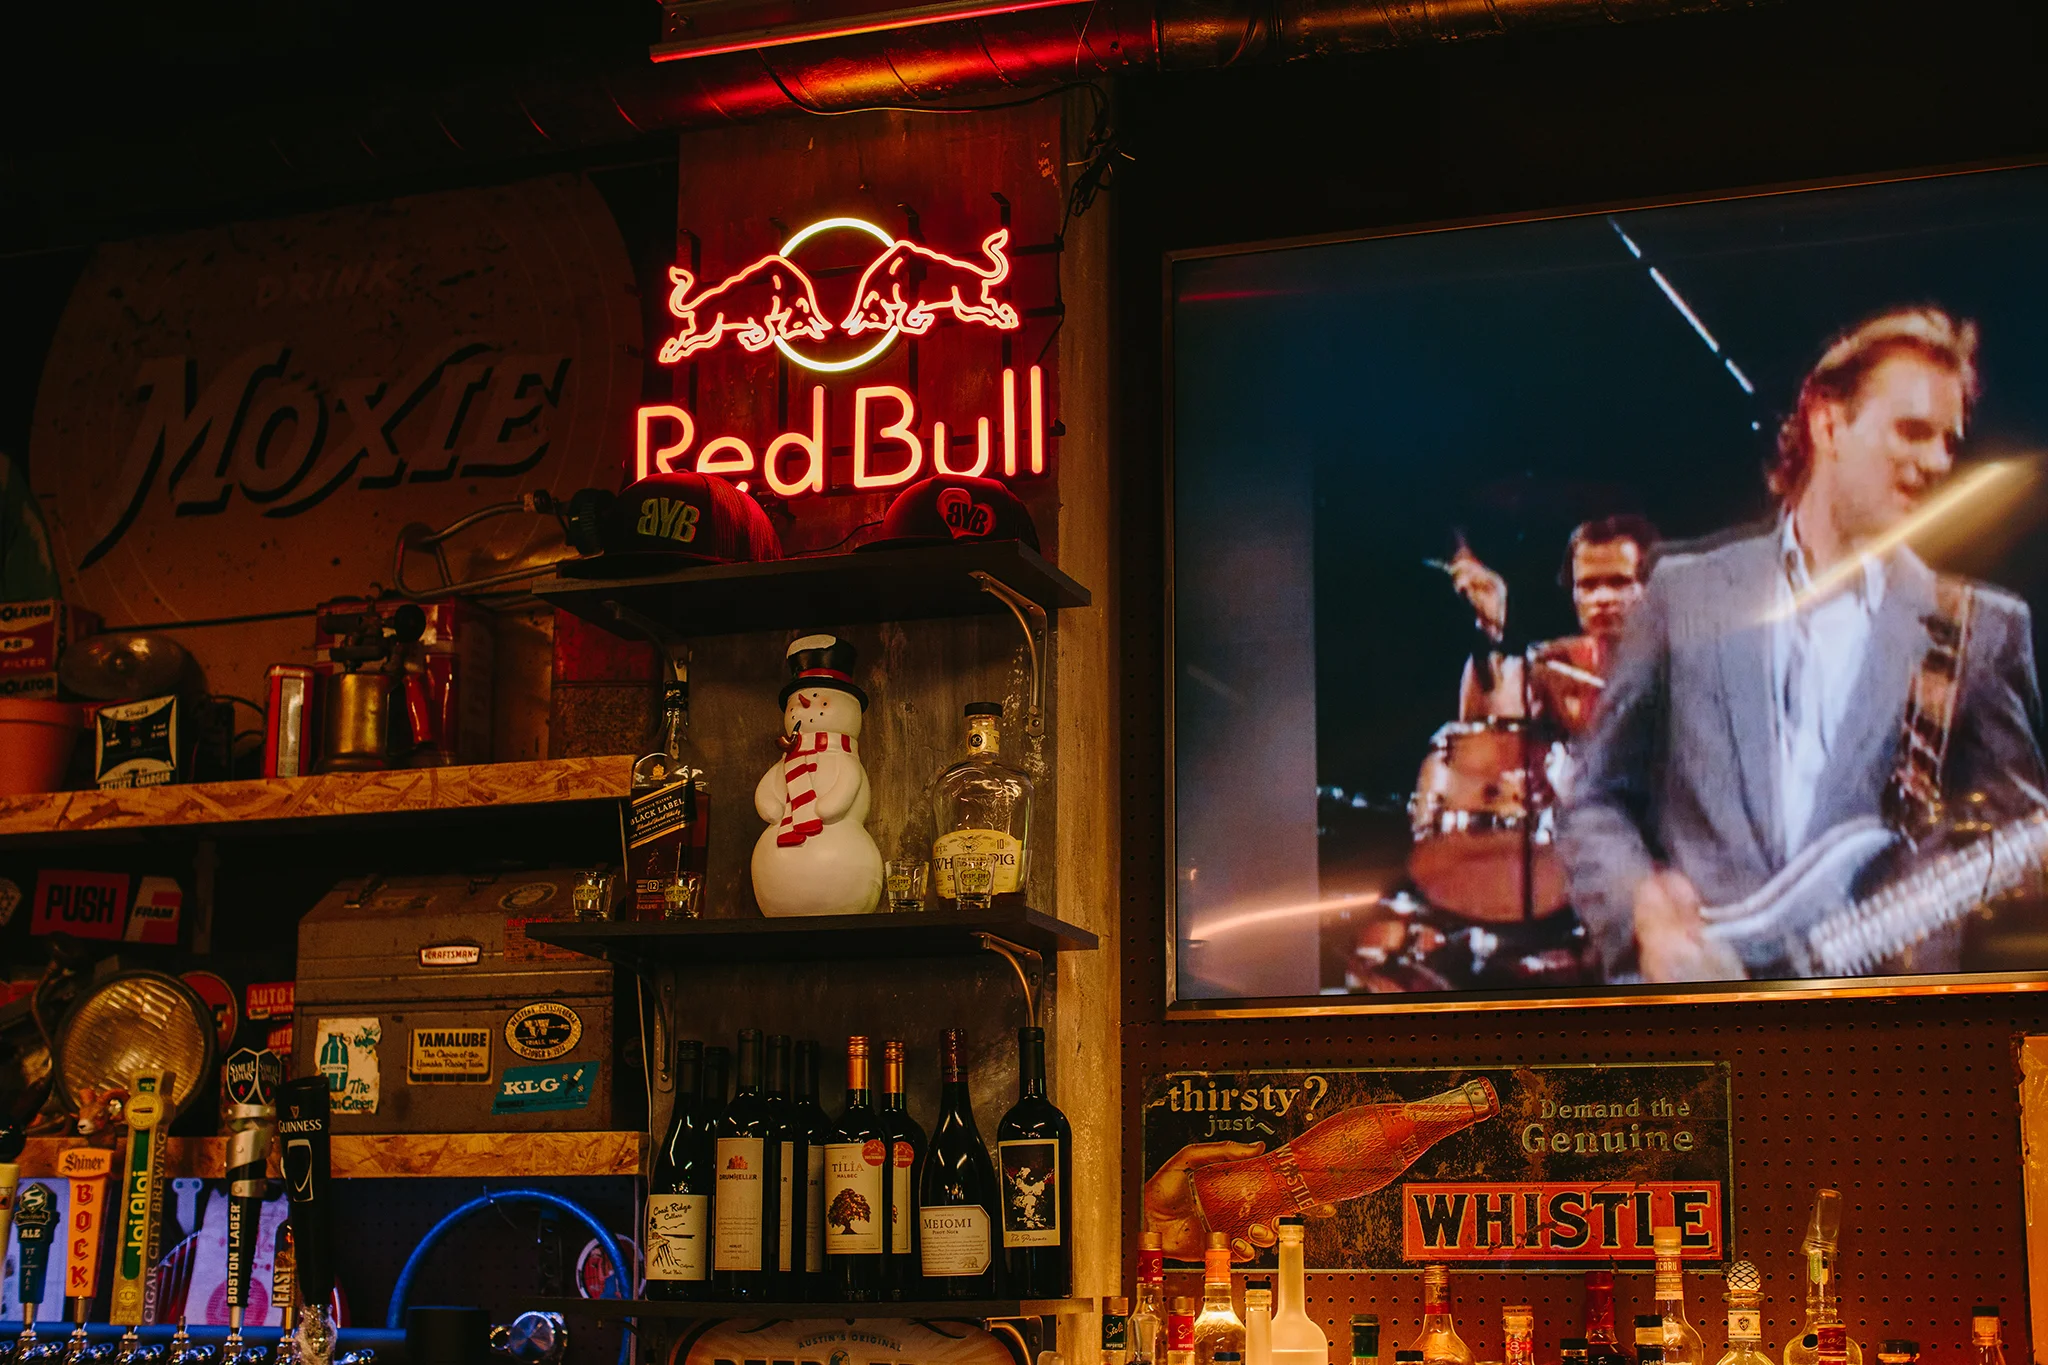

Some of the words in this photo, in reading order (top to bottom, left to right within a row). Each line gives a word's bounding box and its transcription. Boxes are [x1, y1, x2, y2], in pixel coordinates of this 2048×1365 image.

[256, 260, 402, 307] DRINK
[637, 385, 825, 497] Red
[853, 365, 1044, 490] Bull
[81, 343, 572, 570] MOXIE
[0, 606, 51, 621] OLATOR
[0, 677, 54, 694] OLATOR
[657, 797, 685, 815] LABEL
[45, 884, 118, 924] PUSH
[134, 905, 174, 919] FRAM
[427, 949, 474, 960] CRAFTSMAN
[417, 1032, 487, 1048] YAMALUBE
[1166, 1074, 1329, 1122] thirsty?
[1539, 1099, 1636, 1121] Demand
[1650, 1096, 1692, 1118] the
[278, 1118, 323, 1134] GUINNESS
[1204, 1114, 1259, 1138] just
[1521, 1121, 1696, 1154] Genuine
[64, 1152, 105, 1171] Shiner
[150, 1131, 166, 1213] BREWING
[670, 1202, 692, 1214] Ridge
[1411, 1190, 1715, 1249] WHISTLE
[20, 1228, 41, 1238] ALE
[70, 1182, 92, 1290] BOCK
[229, 1203, 241, 1248] LAGER
[923, 1218, 972, 1230] MEIOMI
[148, 1217, 161, 1260] CITY
[227, 1251, 240, 1304] BOSTON
[144, 1266, 158, 1323] CIGAR
[798, 1332, 847, 1349] AUSTIN'S
[849, 1332, 902, 1352] ORIGINAL
